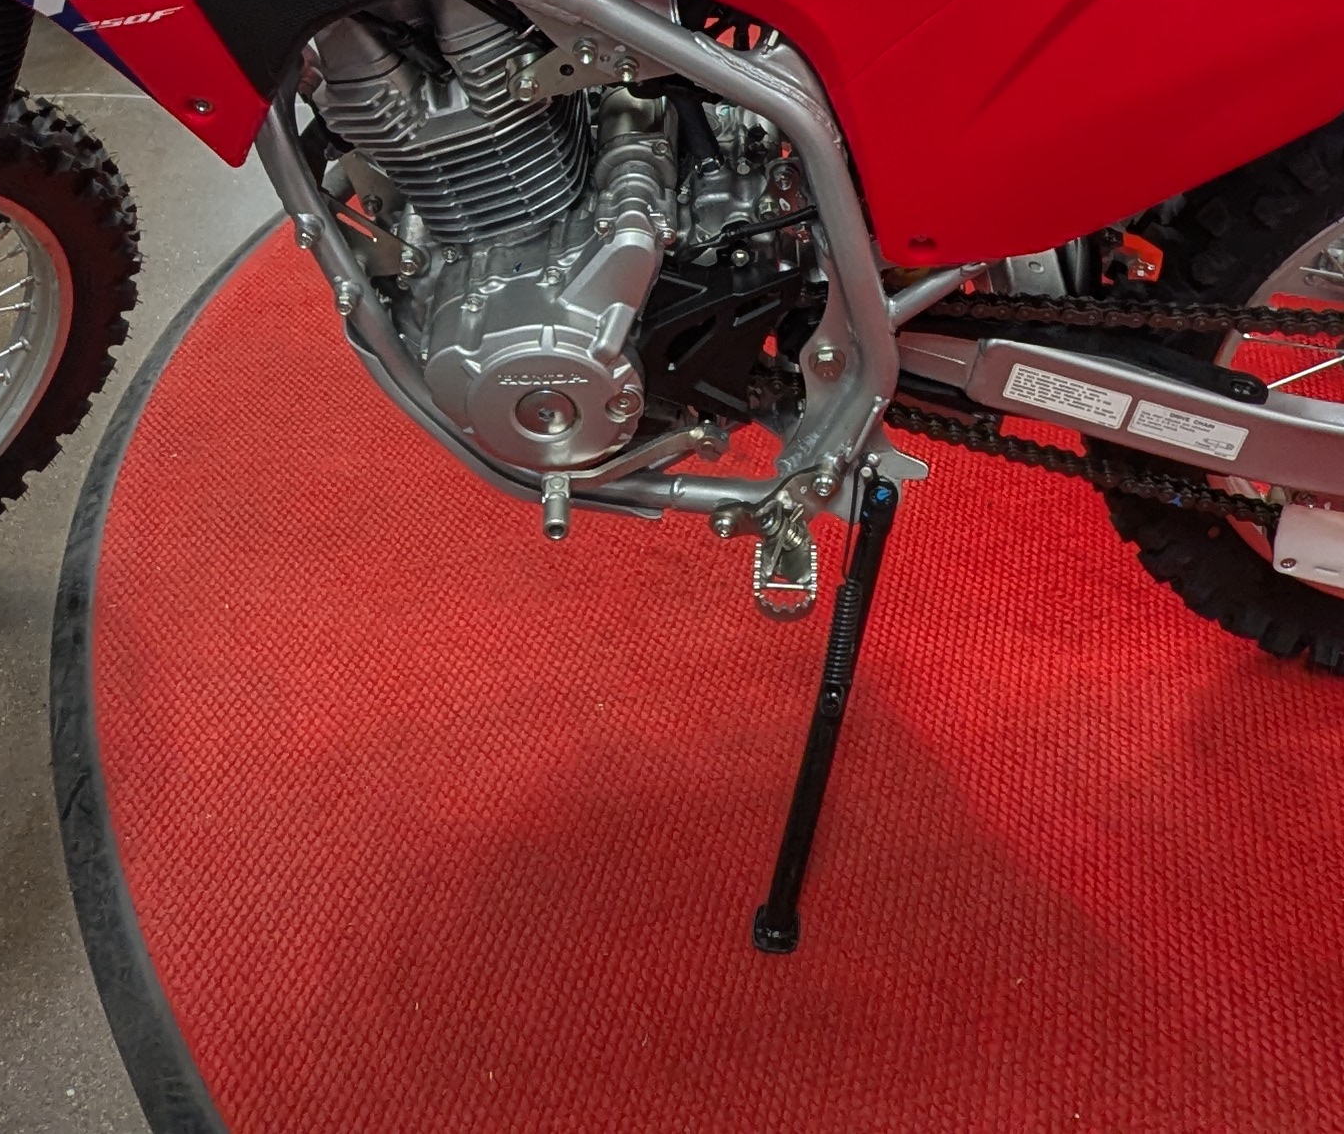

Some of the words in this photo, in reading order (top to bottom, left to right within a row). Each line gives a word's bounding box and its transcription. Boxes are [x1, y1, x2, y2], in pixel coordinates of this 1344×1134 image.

[72, 5, 175, 33] 250F
[498, 372, 589, 386] HONDA
[1169, 412, 1191, 423] DRIVE
[1193, 419, 1216, 430] CHAIN
